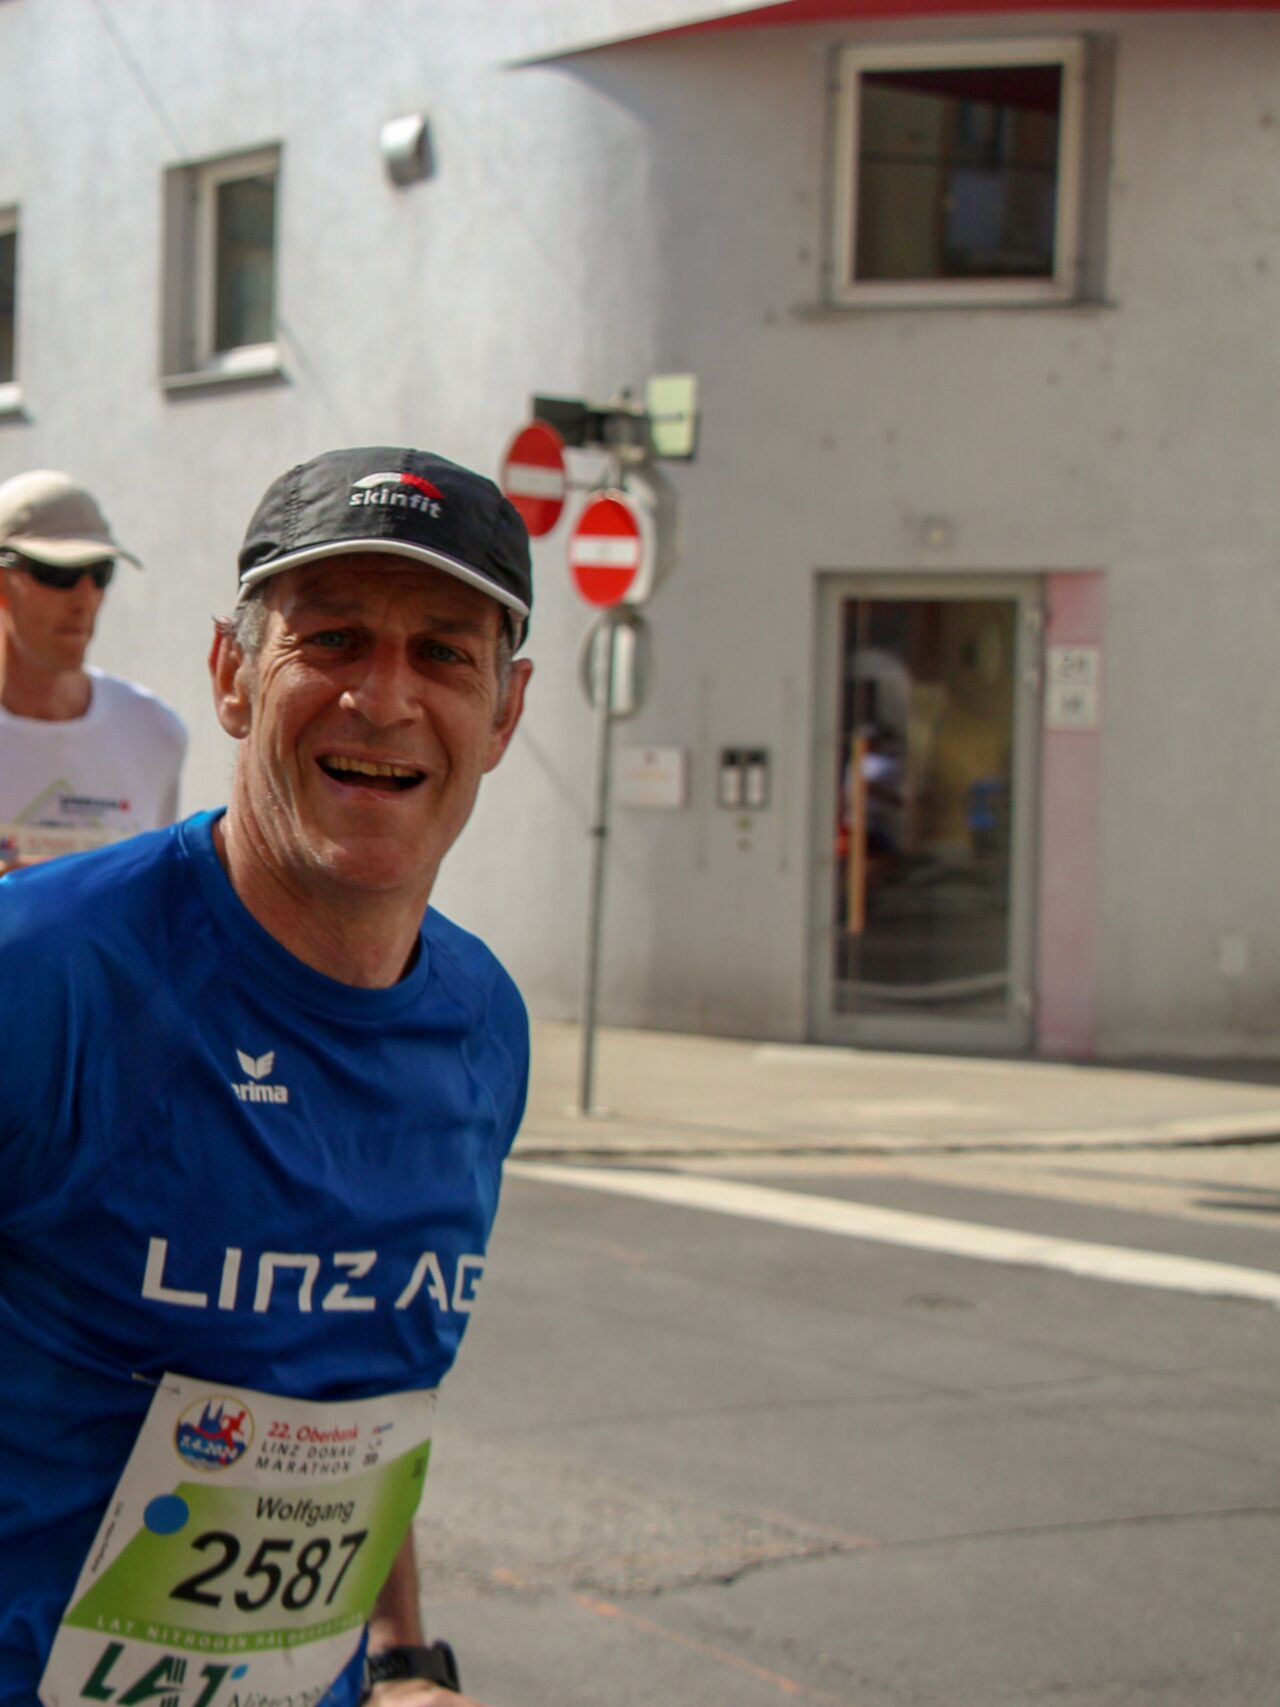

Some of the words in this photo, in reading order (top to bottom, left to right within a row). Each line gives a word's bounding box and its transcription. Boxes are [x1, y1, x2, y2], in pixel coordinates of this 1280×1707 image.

[349, 488, 442, 518] skinfit
[141, 1236, 378, 1313] LINZ
[267, 1421, 291, 1439] 22.
[296, 1424, 358, 1443] Oberbank
[261, 1441, 296, 1457] LINZ
[307, 1443, 356, 1459] DONAU
[255, 1456, 352, 1476] MARATHON
[255, 1497, 355, 1527] Wolfgang
[168, 1528, 370, 1613] 2587
[96, 1613, 135, 1634] LAT
[146, 1625, 247, 1650] NITROGEN
